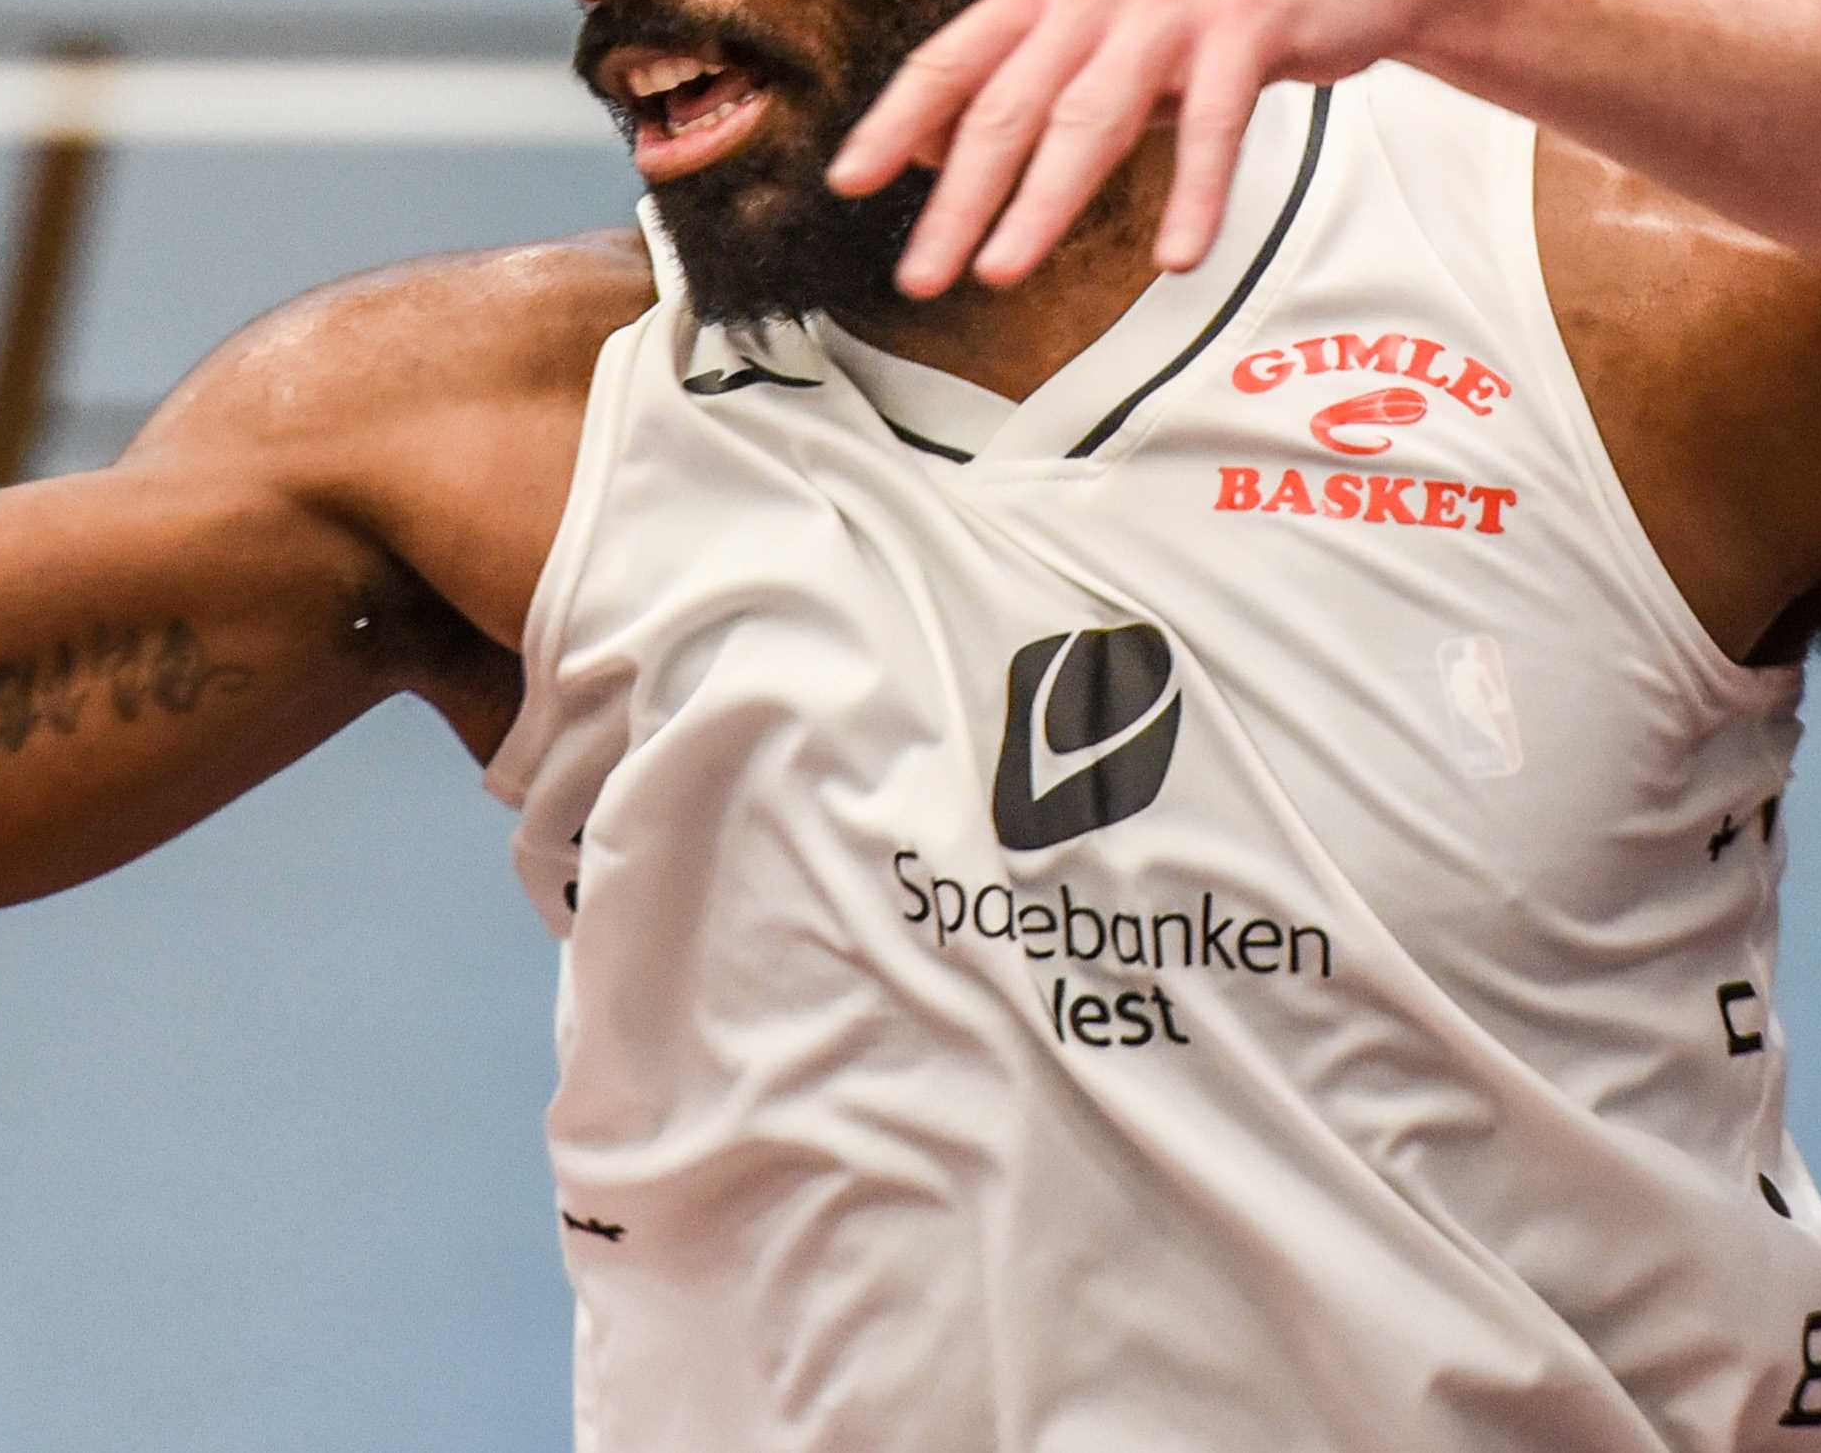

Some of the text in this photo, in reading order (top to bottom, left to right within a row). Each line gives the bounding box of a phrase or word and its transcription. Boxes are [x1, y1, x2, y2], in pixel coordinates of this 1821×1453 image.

[1232, 333, 1511, 416] GIMLE
[1213, 467, 1517, 534] BASKET
[893, 851, 1331, 978] Spaebanken
